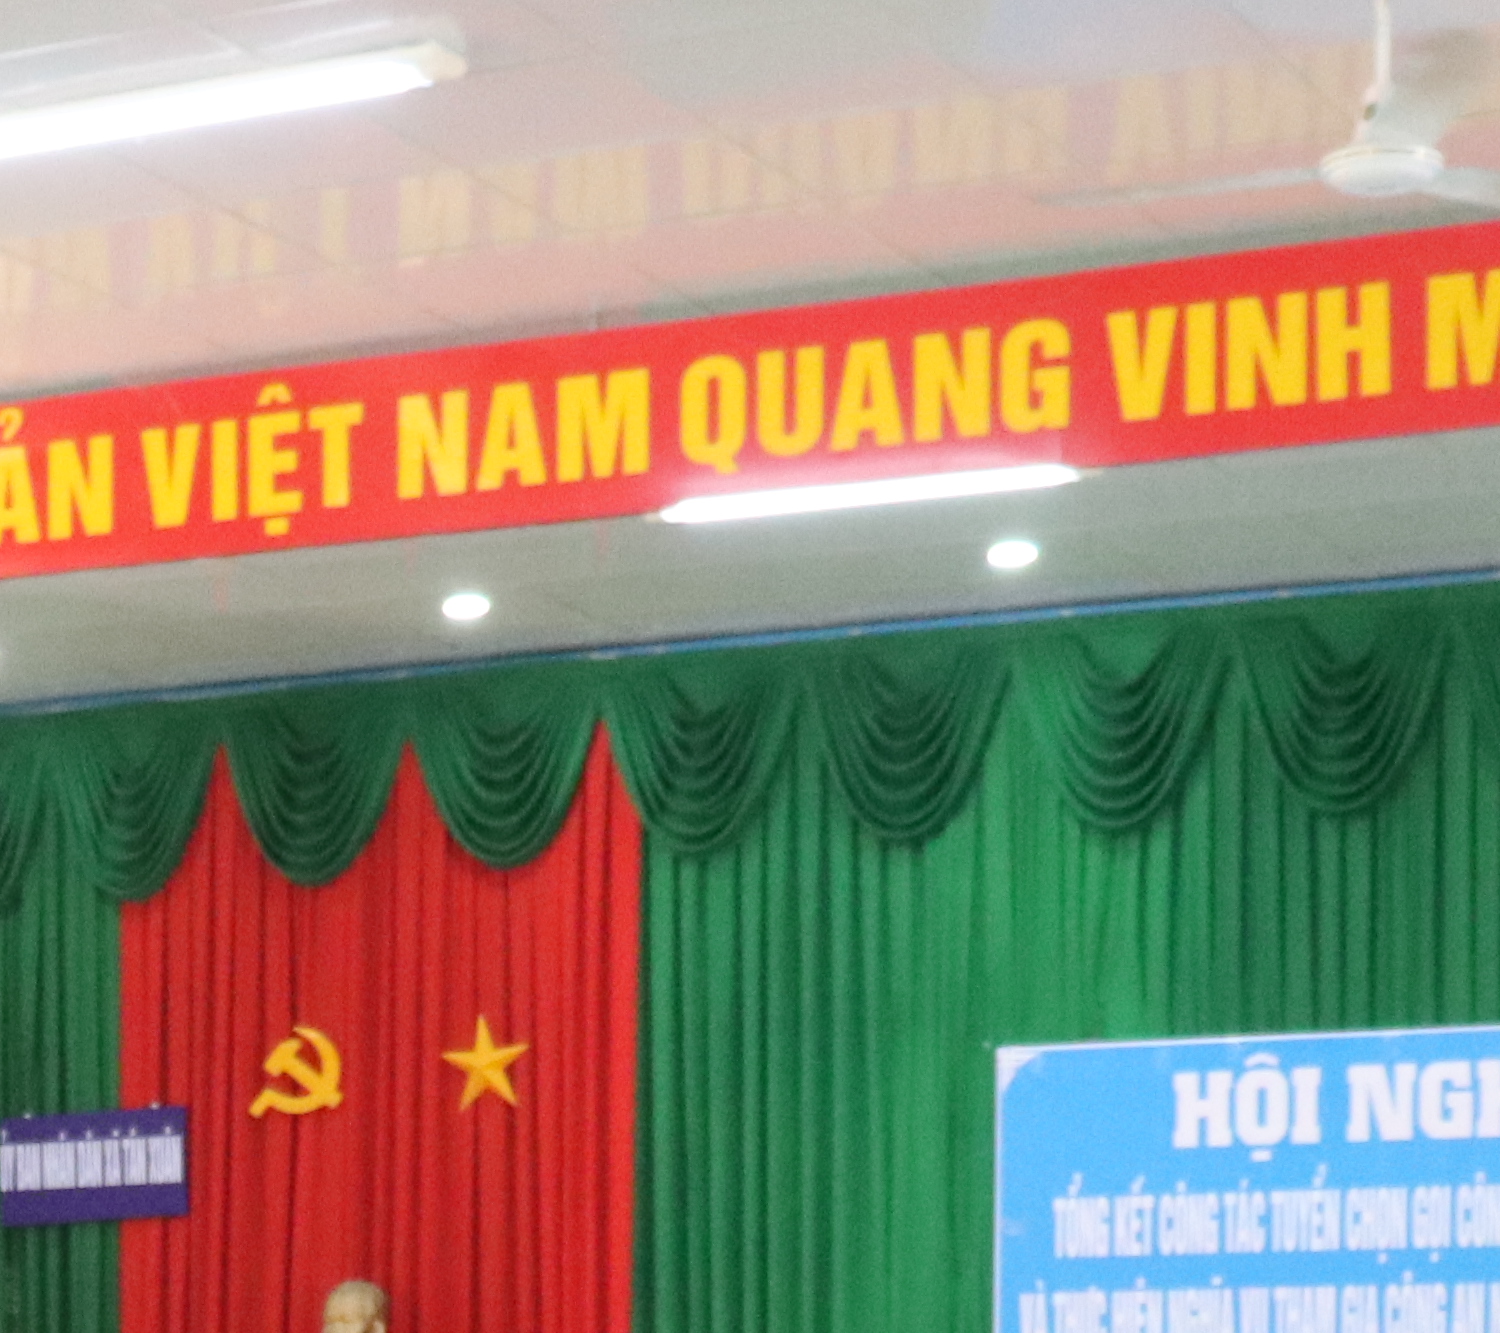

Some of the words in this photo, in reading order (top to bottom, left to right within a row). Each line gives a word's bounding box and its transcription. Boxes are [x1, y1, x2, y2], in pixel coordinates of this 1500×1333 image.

[140, 383, 364, 539] VIỆT
[395, 366, 651, 499] NAM
[677, 315, 1071, 475] QUANG
[1107, 280, 1394, 427] VINH
[1171, 1052, 1323, 1161] HỘI
[1113, 1175, 1155, 1256] KẾT
[1159, 1181, 1219, 1255] CÔNG
[1222, 1179, 1267, 1253] TÁC
[1345, 1186, 1408, 1264] CHỌN
